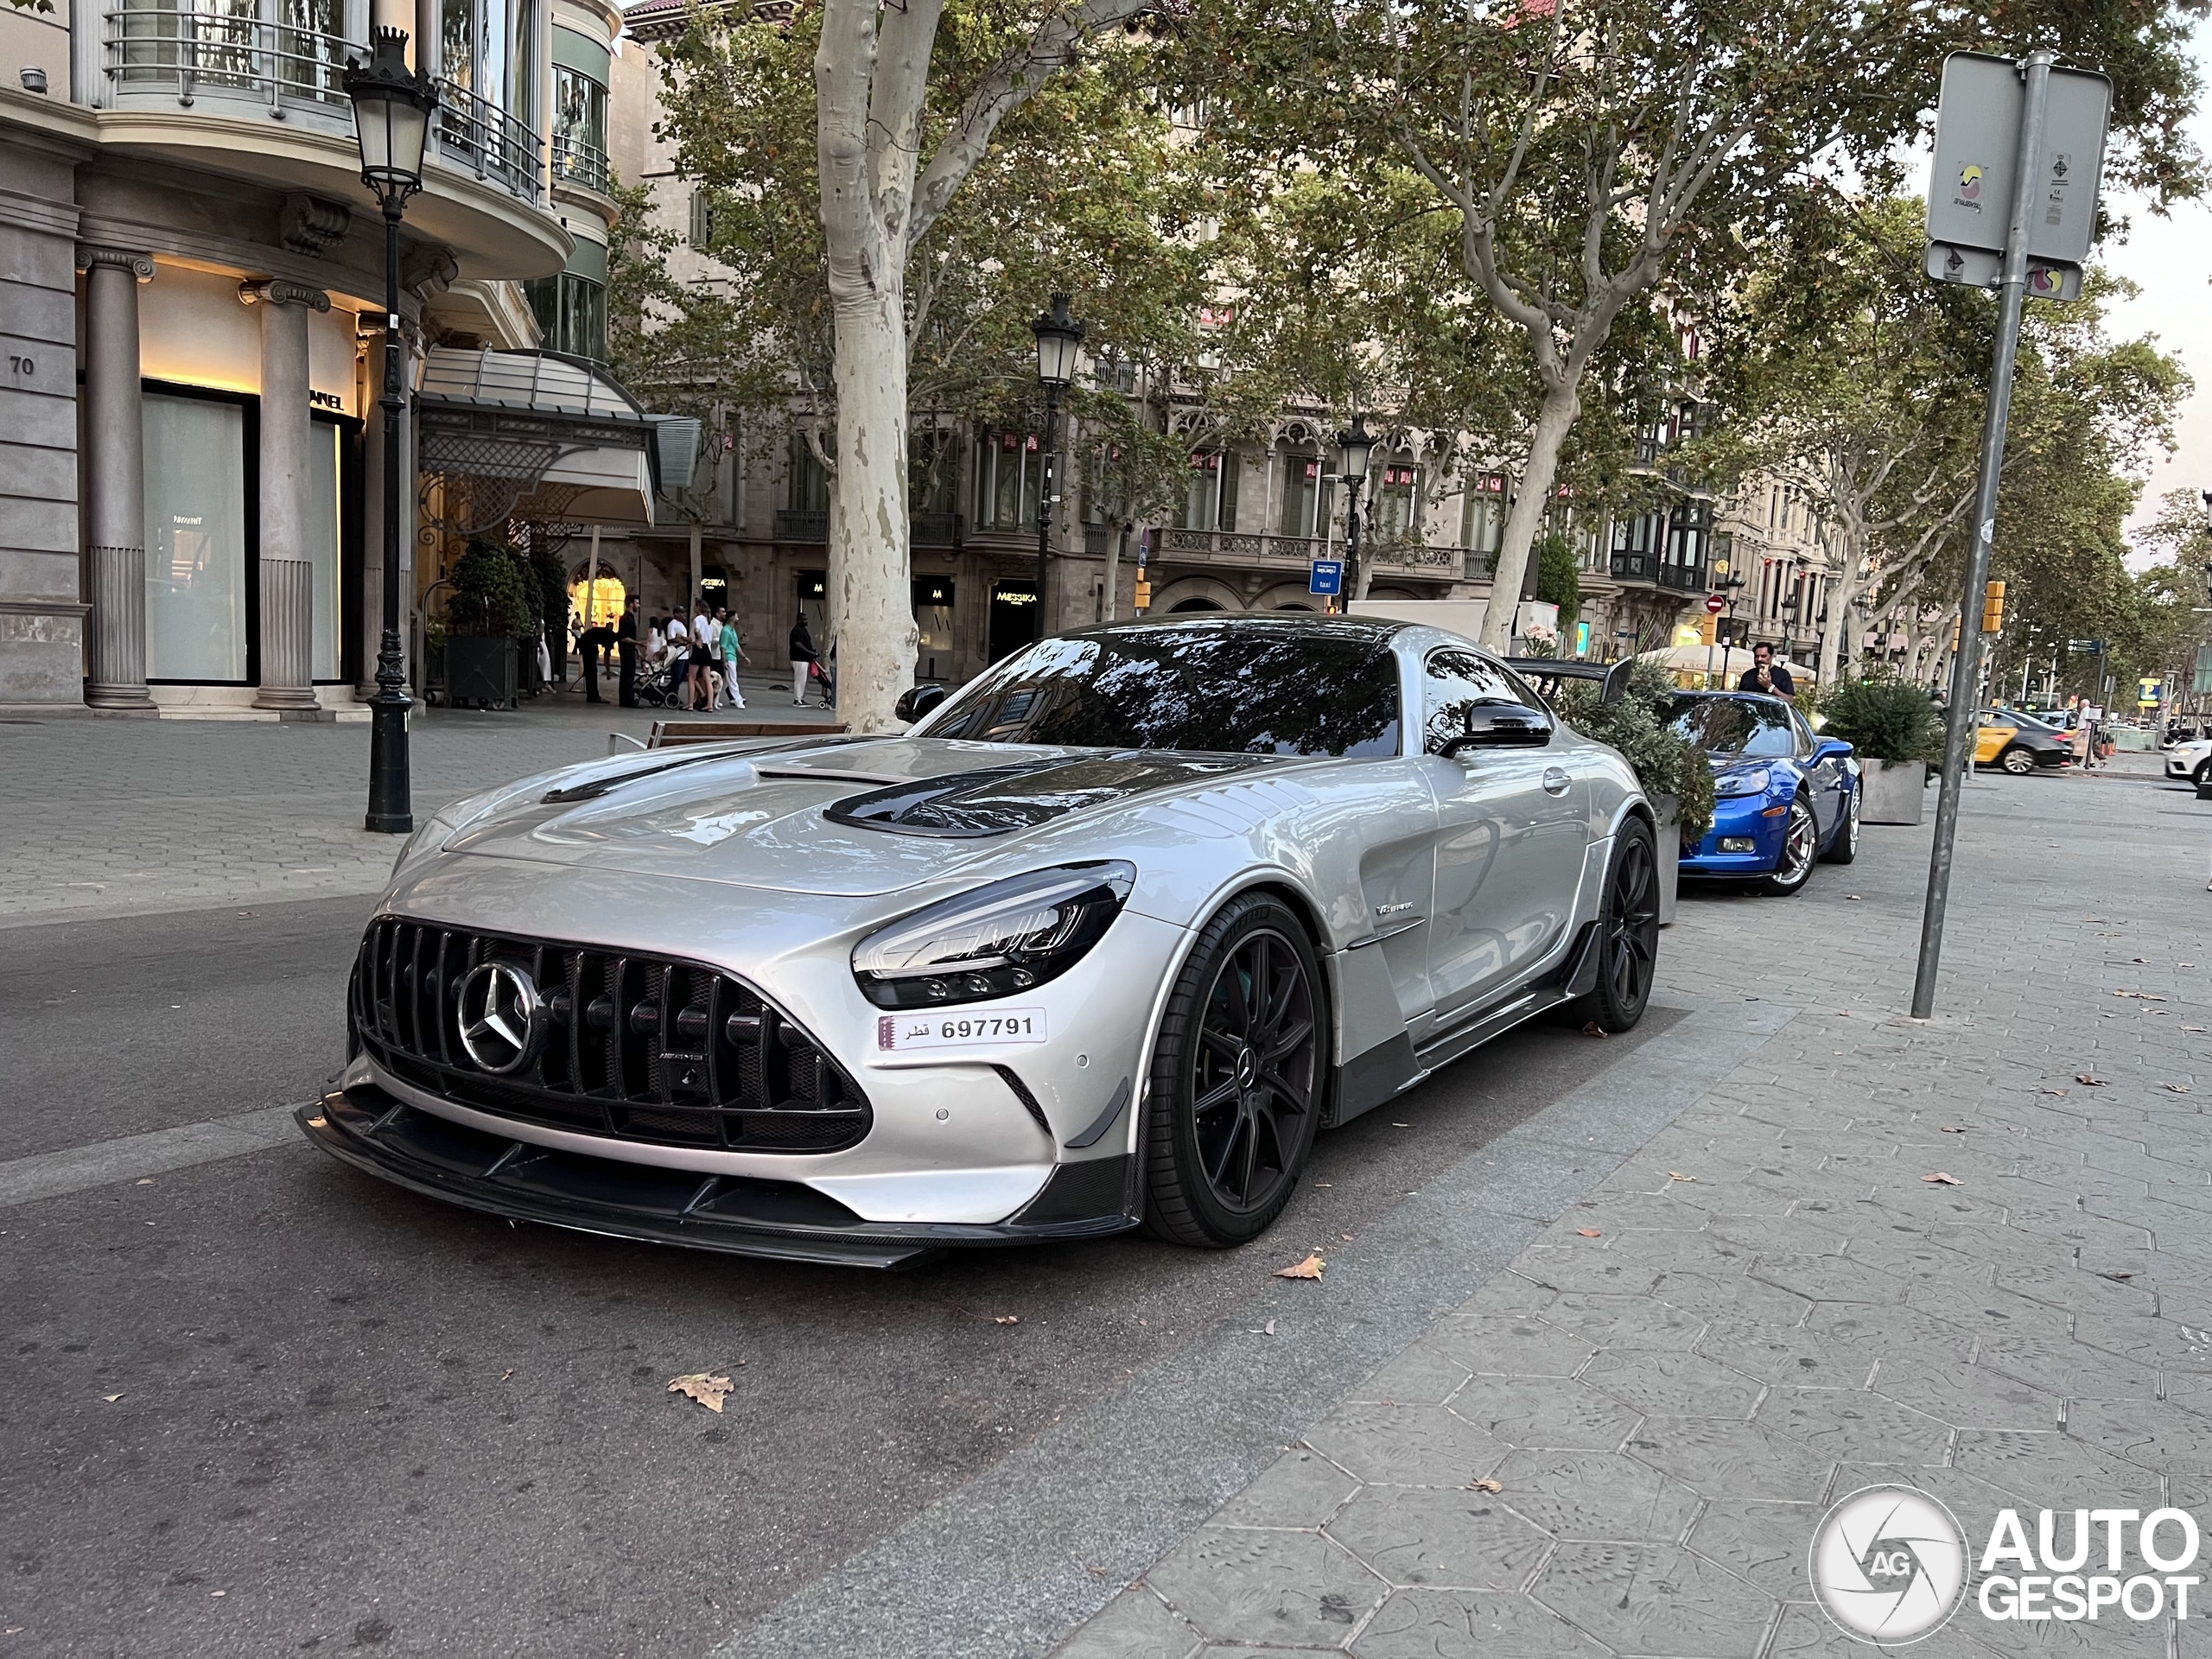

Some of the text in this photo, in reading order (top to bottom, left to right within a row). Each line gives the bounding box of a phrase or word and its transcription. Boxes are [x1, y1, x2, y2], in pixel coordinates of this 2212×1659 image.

[10, 355, 34, 375] 70
[309, 390, 344, 410] ANEL
[701, 578, 725, 587] ESSIKA
[933, 589, 942, 598] M
[996, 592, 1037, 602] MESSIKA
[904, 1023, 930, 1040] قطر
[941, 1017, 1033, 1039] 697791
